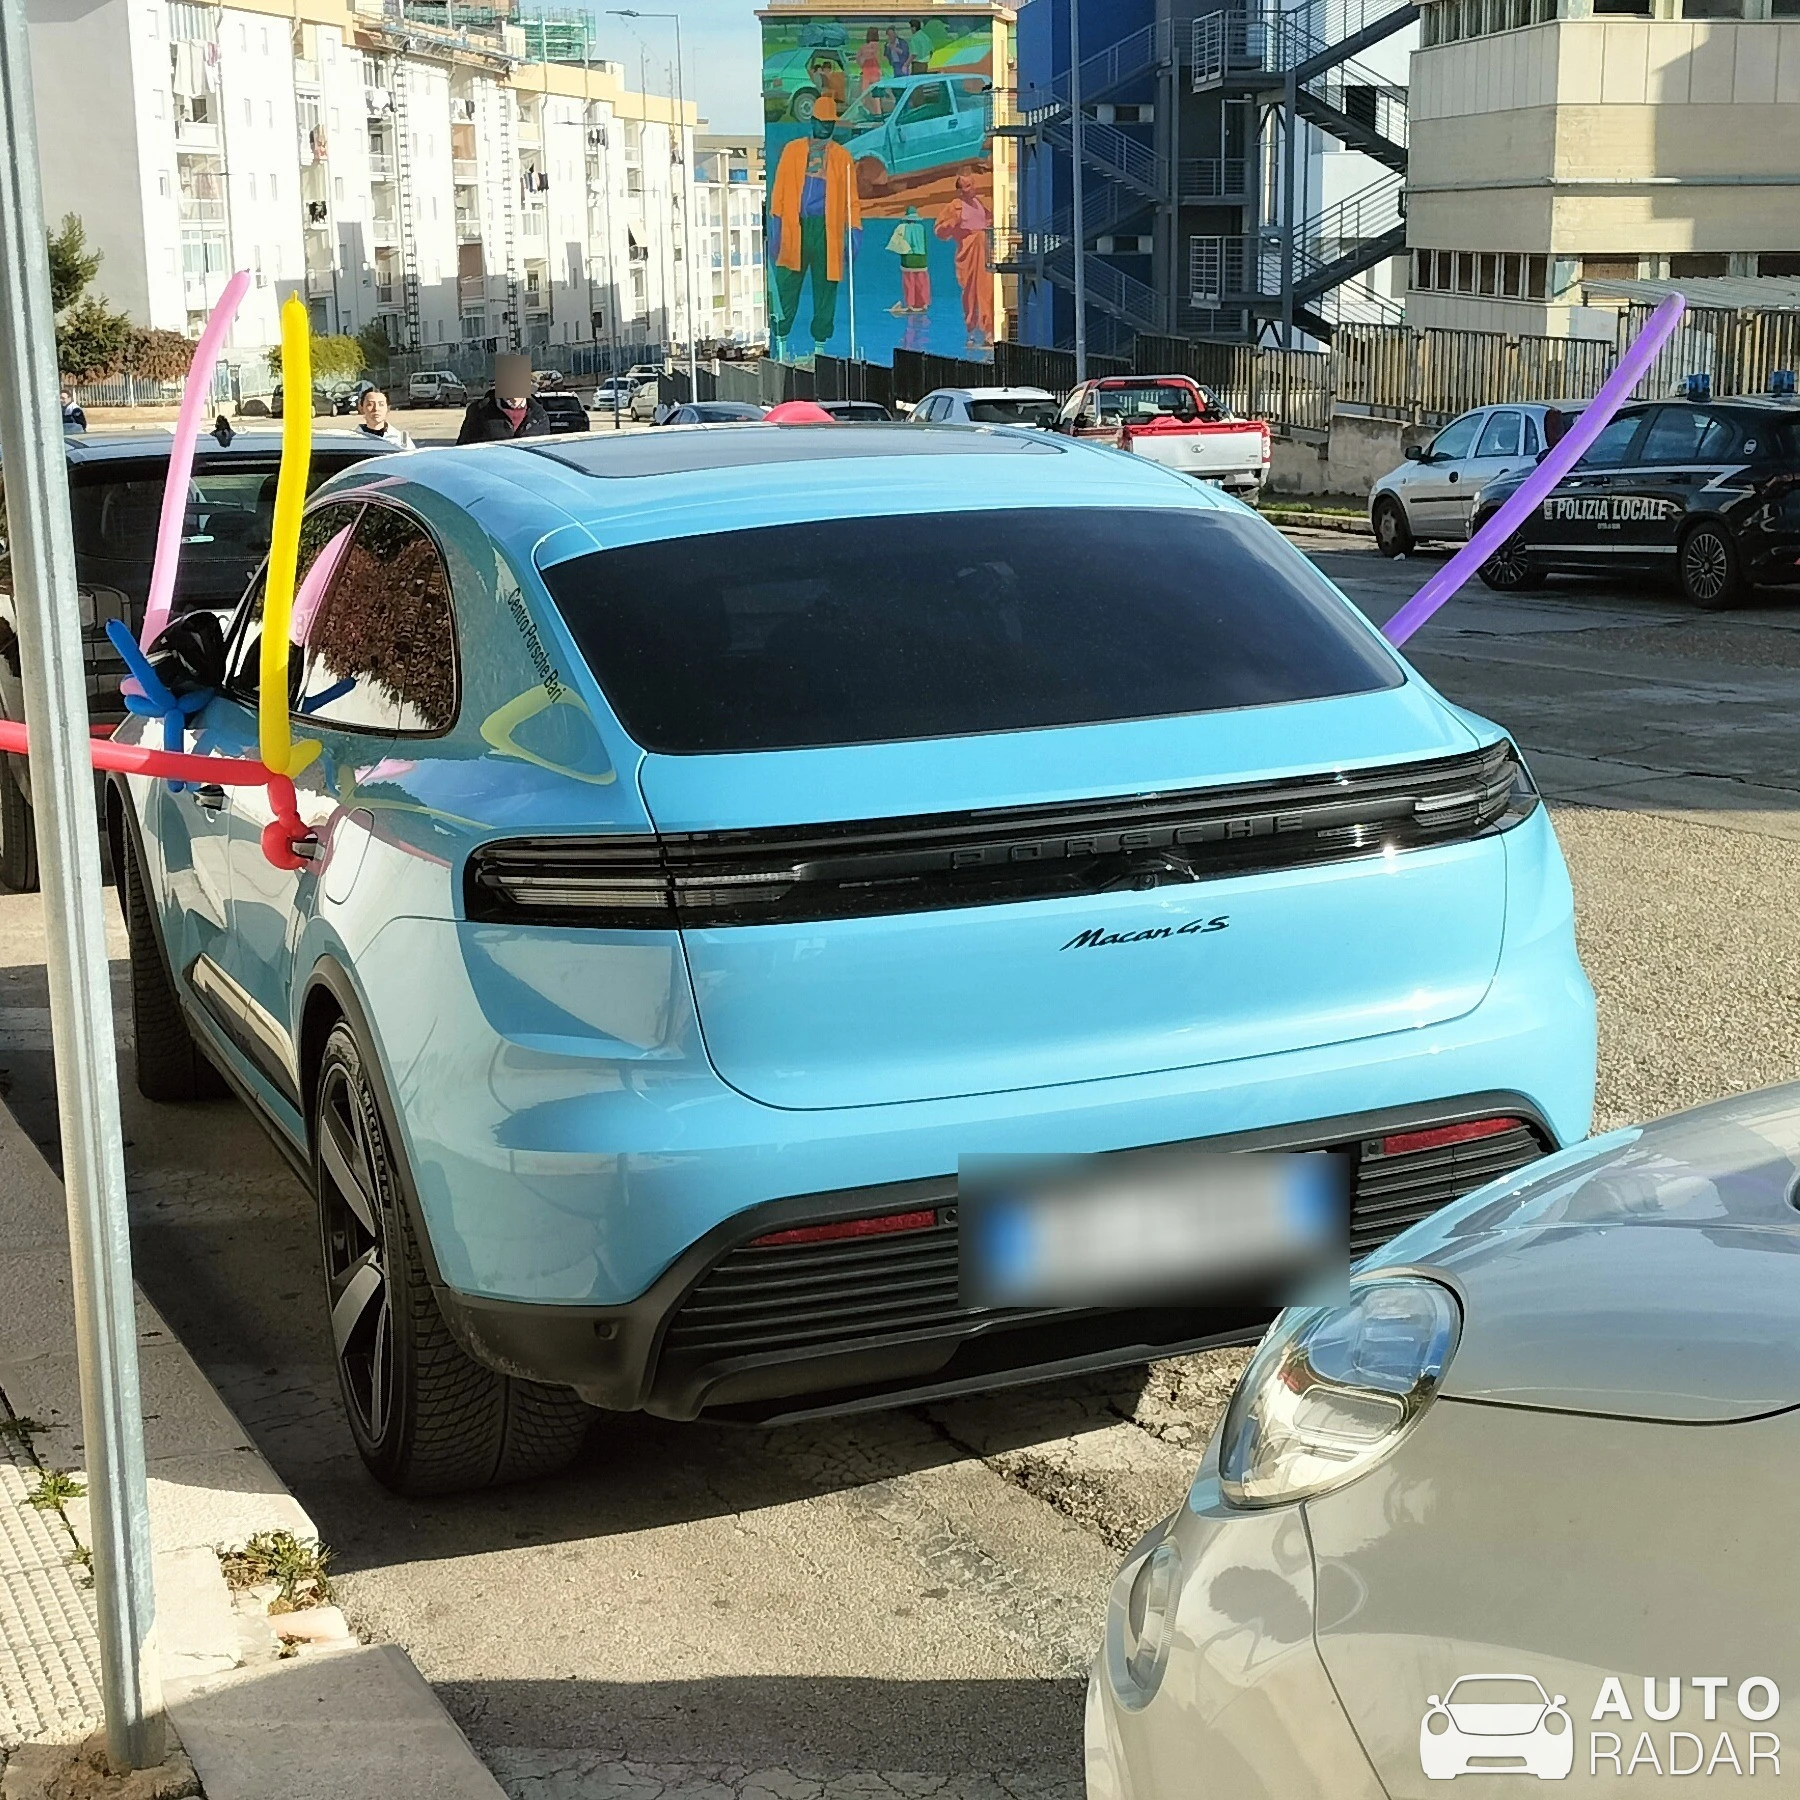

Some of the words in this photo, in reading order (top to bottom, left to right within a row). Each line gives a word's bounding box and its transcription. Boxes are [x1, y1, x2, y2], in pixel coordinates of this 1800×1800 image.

[1556, 499, 1609, 521] POLIZIA
[1612, 499, 1666, 521] LOCALE
[507, 586, 529, 633] Centro
[522, 622, 550, 679] Porsche
[543, 668, 567, 704] Bari
[953, 815, 1302, 868] PORSCHE
[1059, 927, 1174, 951] Macan
[363, 1090, 390, 1201] MICHELIN
